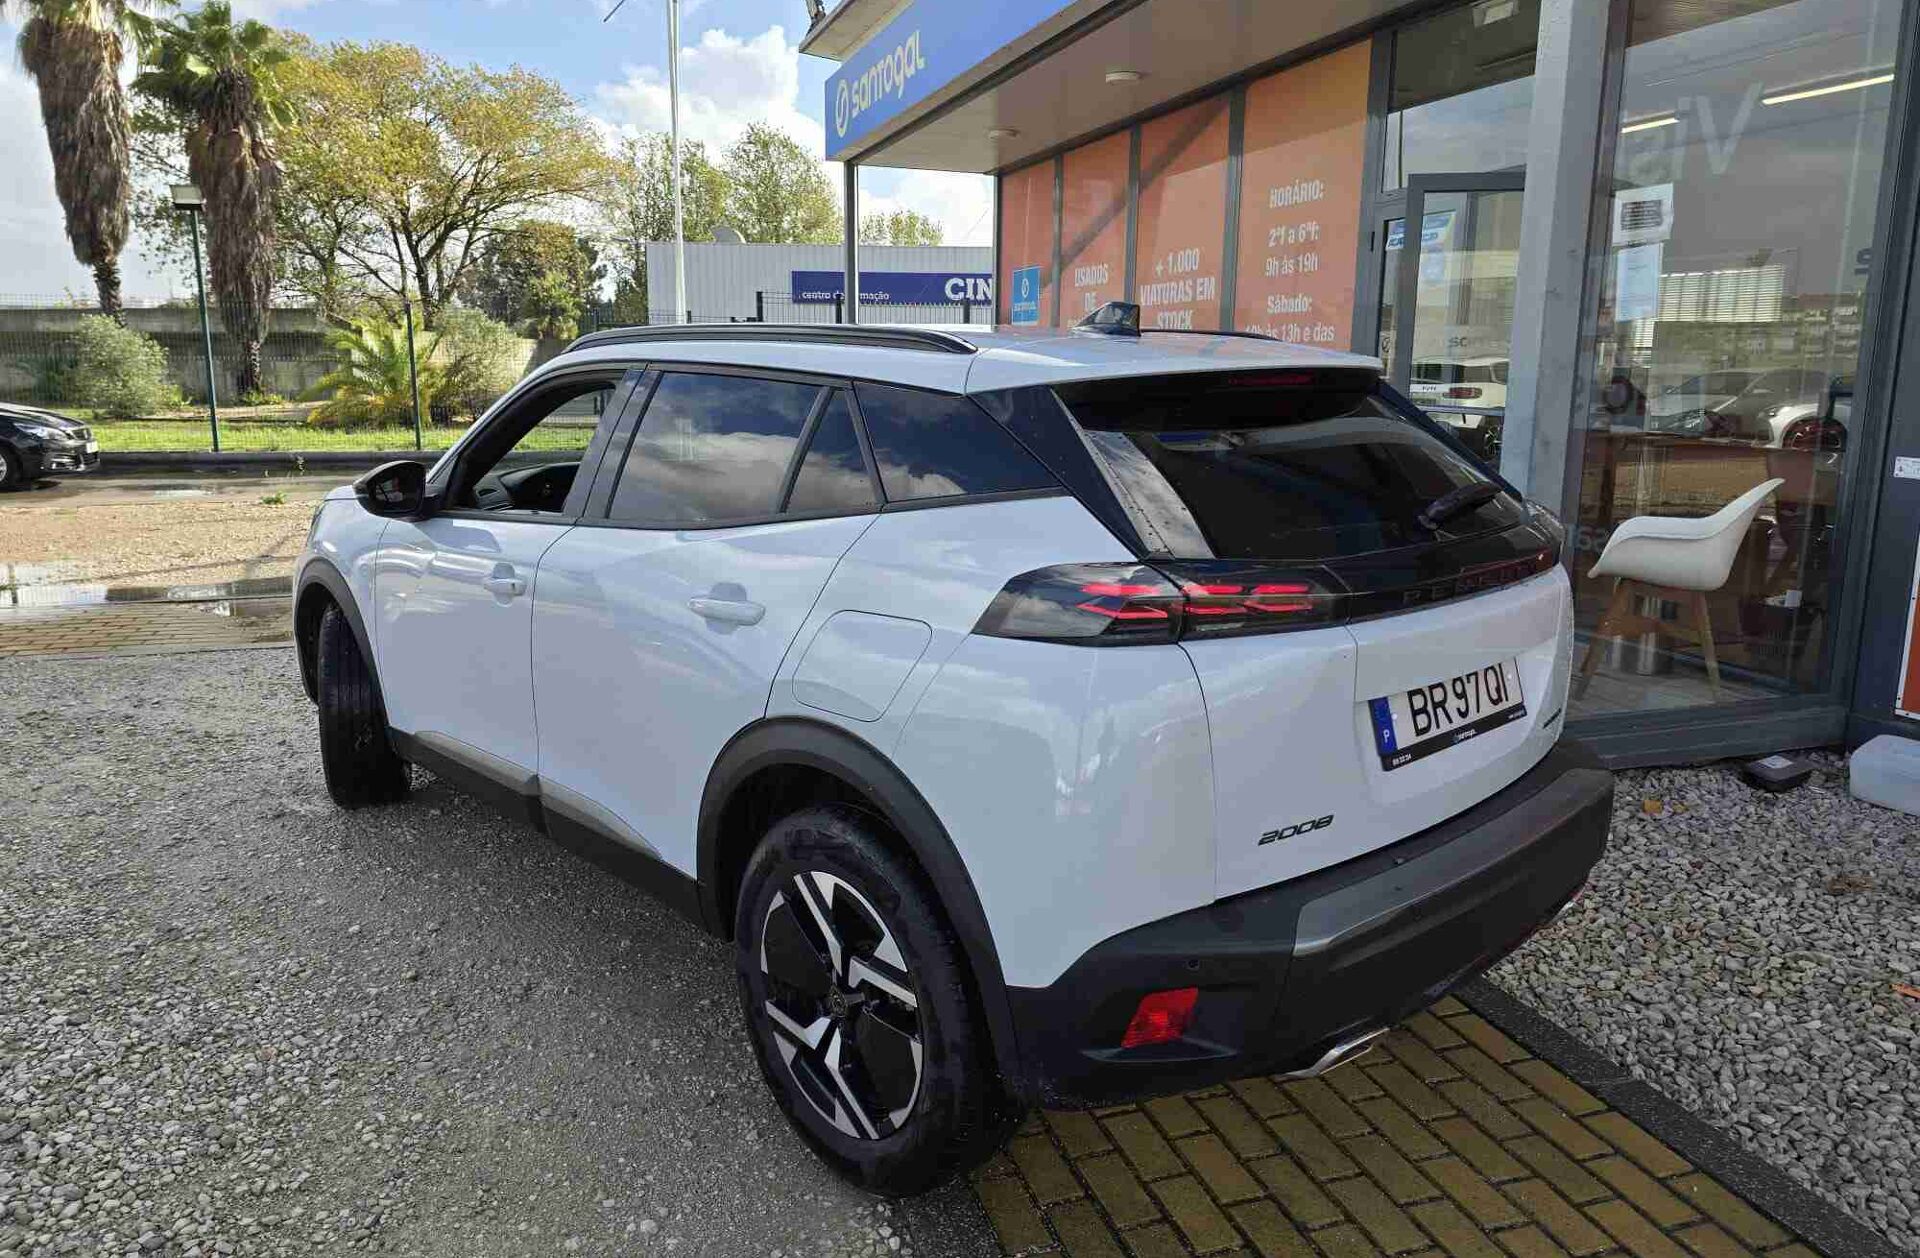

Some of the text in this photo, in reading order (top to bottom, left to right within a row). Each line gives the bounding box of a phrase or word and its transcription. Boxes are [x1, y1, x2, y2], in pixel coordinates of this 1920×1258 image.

[852, 30, 925, 118] santogal
[1268, 178, 1324, 208] HORÁRIO:
[1288, 230, 1296, 244] a
[1167, 247, 1200, 274] 1.000
[1265, 257, 1279, 277] 9h
[1298, 252, 1318, 273] 19h
[1074, 262, 1109, 287] USADOS
[802, 291, 831, 300] centro
[1140, 276, 1216, 306] VIATURAS EM
[1267, 292, 1312, 314] Sábado:
[1157, 309, 1193, 330] STOCK
[1303, 326, 1312, 341] e
[1313, 320, 1335, 342] das
[1407, 662, 1509, 736] BR 97 QI
[1383, 729, 1390, 743] P
[1258, 814, 1334, 846] 2008
